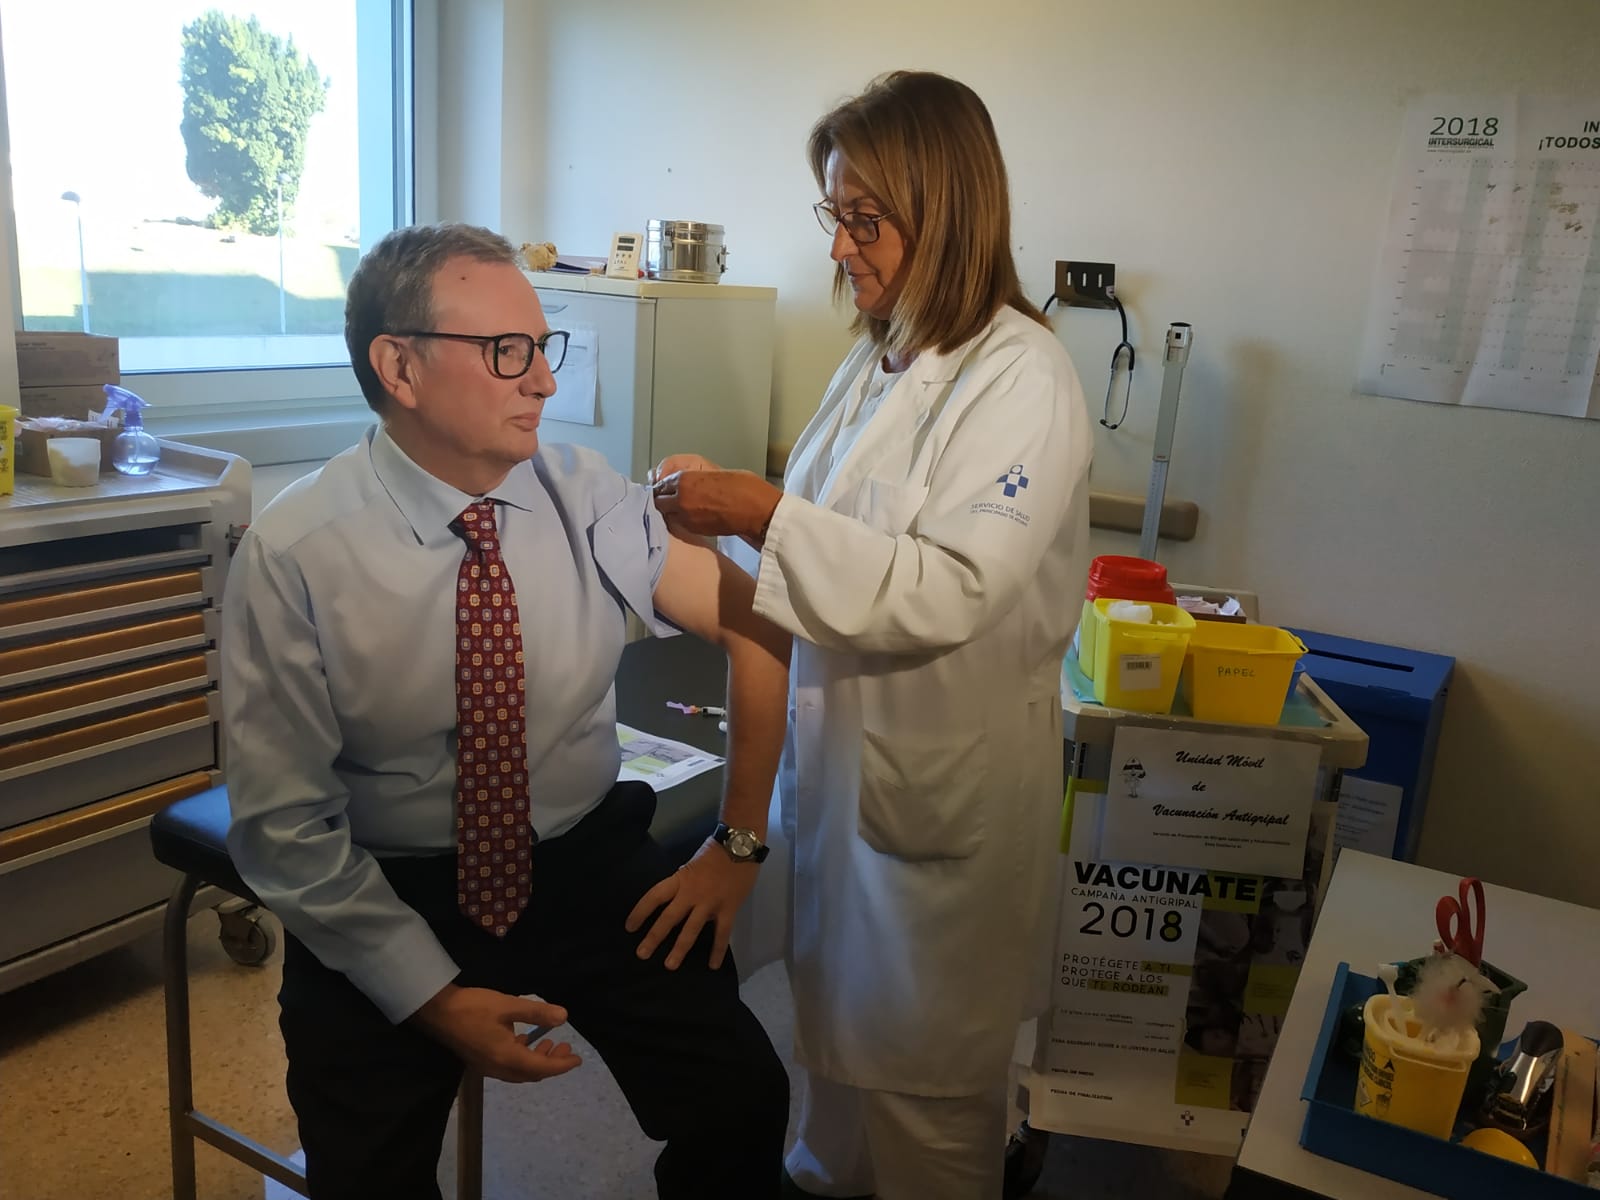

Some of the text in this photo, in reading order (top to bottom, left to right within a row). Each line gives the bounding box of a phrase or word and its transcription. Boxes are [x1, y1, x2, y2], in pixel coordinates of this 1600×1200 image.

[1430, 117, 1498, 136] 2018
[1428, 138, 1495, 146] INTERSURGICAL
[1175, 750, 1265, 769] Unidad Móvil
[1191, 780, 1207, 792] de
[1152, 804, 1290, 826] Vacunación Antigripal
[1074, 861, 1258, 901] VACÚNATE
[1071, 888, 1198, 909] CAMPAÑA ANTIGRIPAL
[1080, 902, 1182, 942] 2018
[1063, 953, 1170, 973] PROTÉGETE A TI
[1061, 976, 1087, 988] QUE
[1093, 980, 1106, 990] TE
[1062, 965, 1163, 984] PROTEGE A LOS
